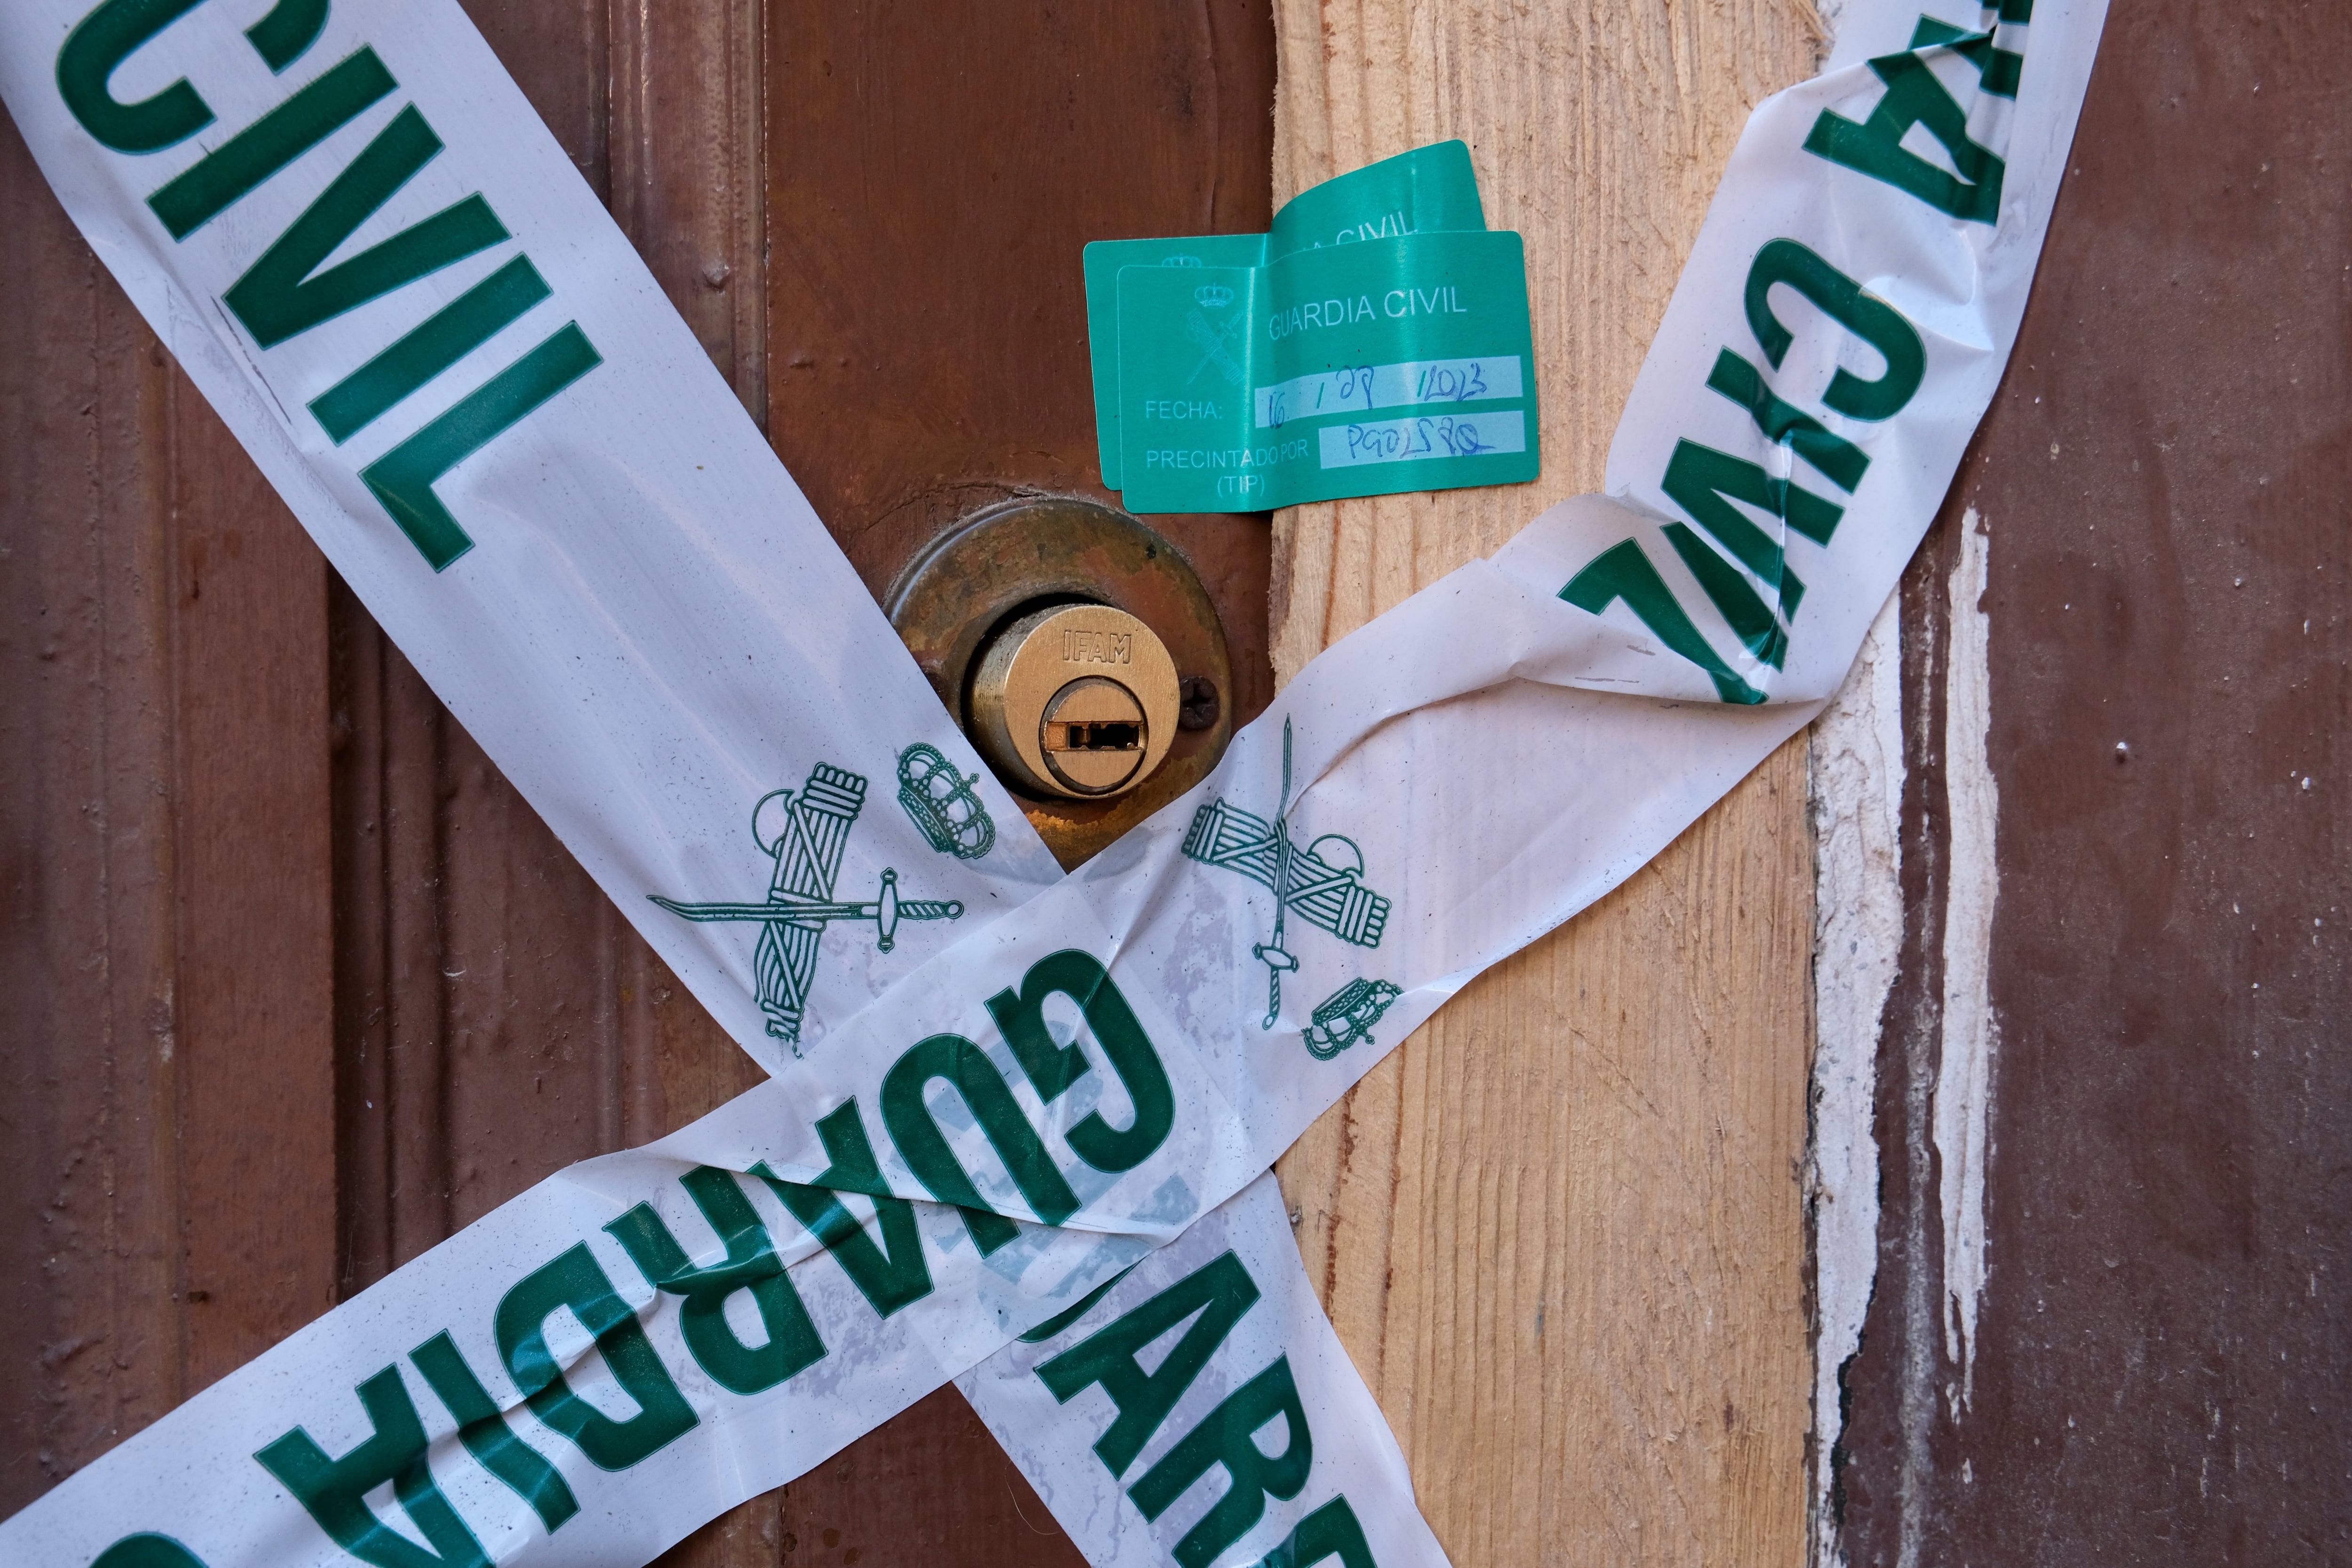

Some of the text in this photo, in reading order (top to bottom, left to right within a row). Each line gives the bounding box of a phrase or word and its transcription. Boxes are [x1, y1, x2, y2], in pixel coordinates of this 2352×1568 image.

[56, 0, 604, 574] CIVIL
[1269, 286, 1467, 340] GUARDIA CIVIL
[1145, 400, 1223, 420] FECHA:
[1146, 438, 1309, 468] PRECINTADO POR
[1557, 237, 1927, 705] CIVIL
[1217, 474, 1265, 499] (TIP)
[1062, 629, 1132, 664] IFAM
[253, 948, 1176, 1568] GUARDIA
